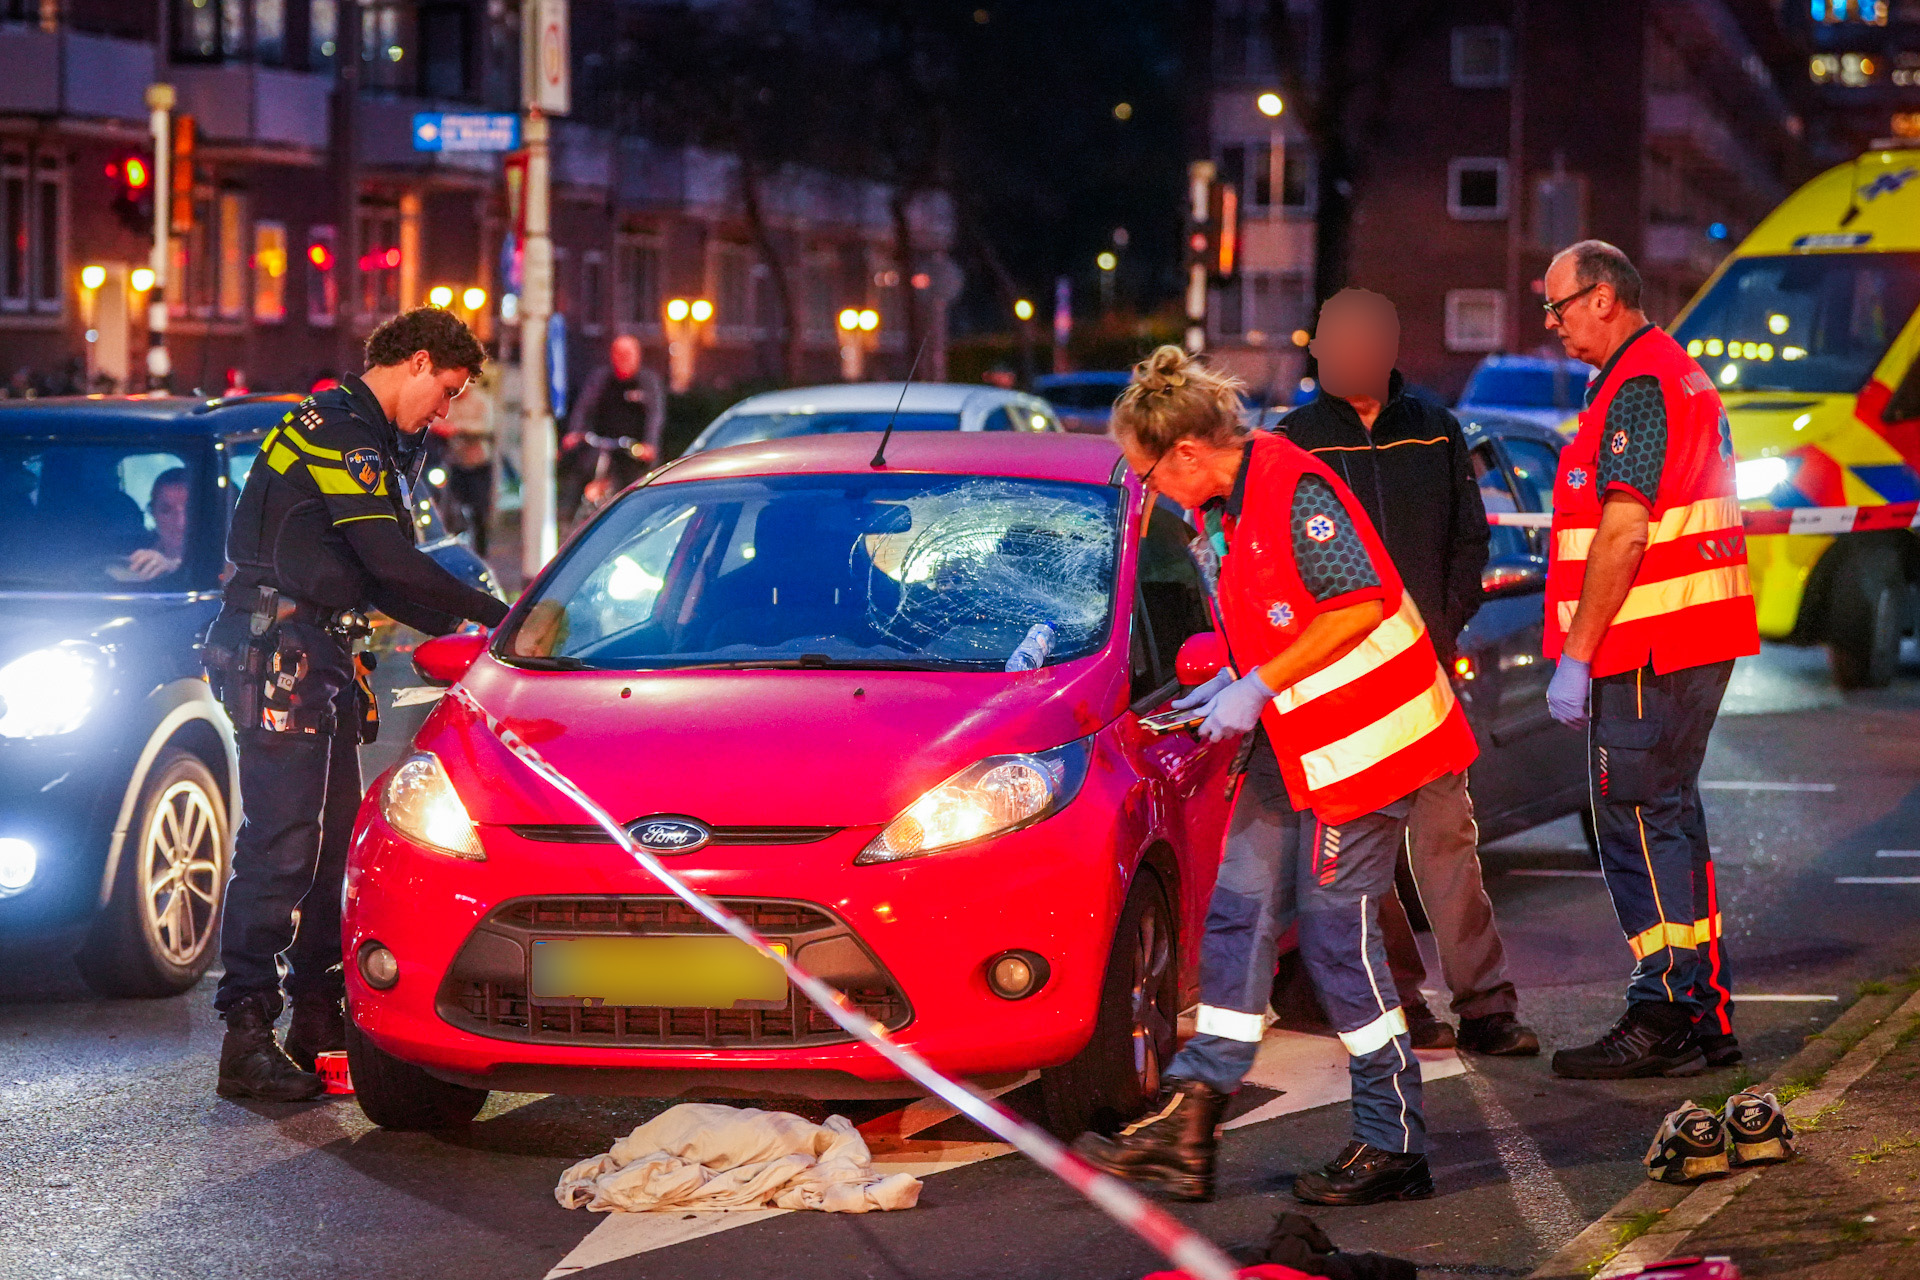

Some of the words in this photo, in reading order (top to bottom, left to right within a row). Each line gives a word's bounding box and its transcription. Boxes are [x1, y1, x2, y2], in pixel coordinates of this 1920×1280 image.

[642, 824, 688, 844] Ford
[1744, 1107, 1760, 1116] NIKE
[1695, 1121, 1710, 1130] NIKE
